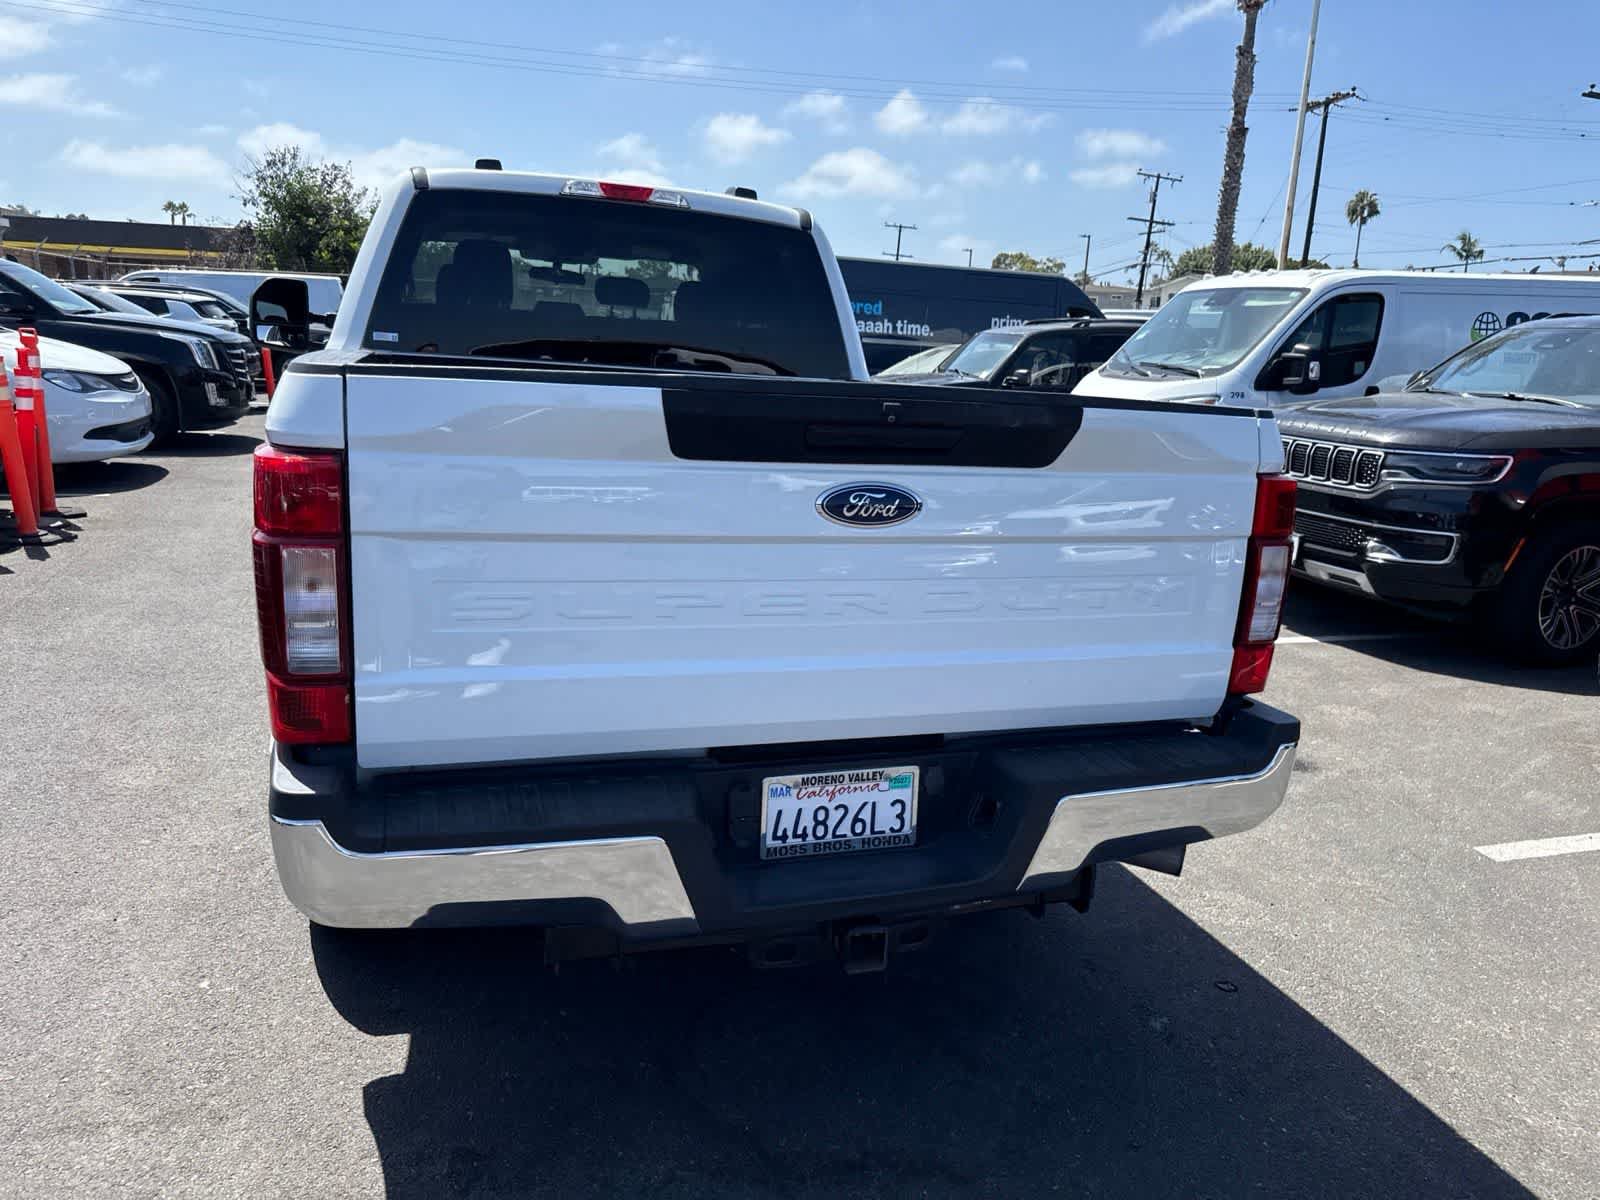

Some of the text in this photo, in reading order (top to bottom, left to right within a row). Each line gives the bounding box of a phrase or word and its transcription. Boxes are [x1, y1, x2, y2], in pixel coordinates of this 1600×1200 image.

[896, 319, 934, 337] time.
[843, 491, 900, 517] Ford
[801, 770, 884, 787] MORENO VALLEY
[770, 785, 792, 798] MAR
[796, 782, 889, 802] California
[771, 799, 906, 844] 44826L3
[766, 835, 911, 858] MOSS BROS. HONDA
